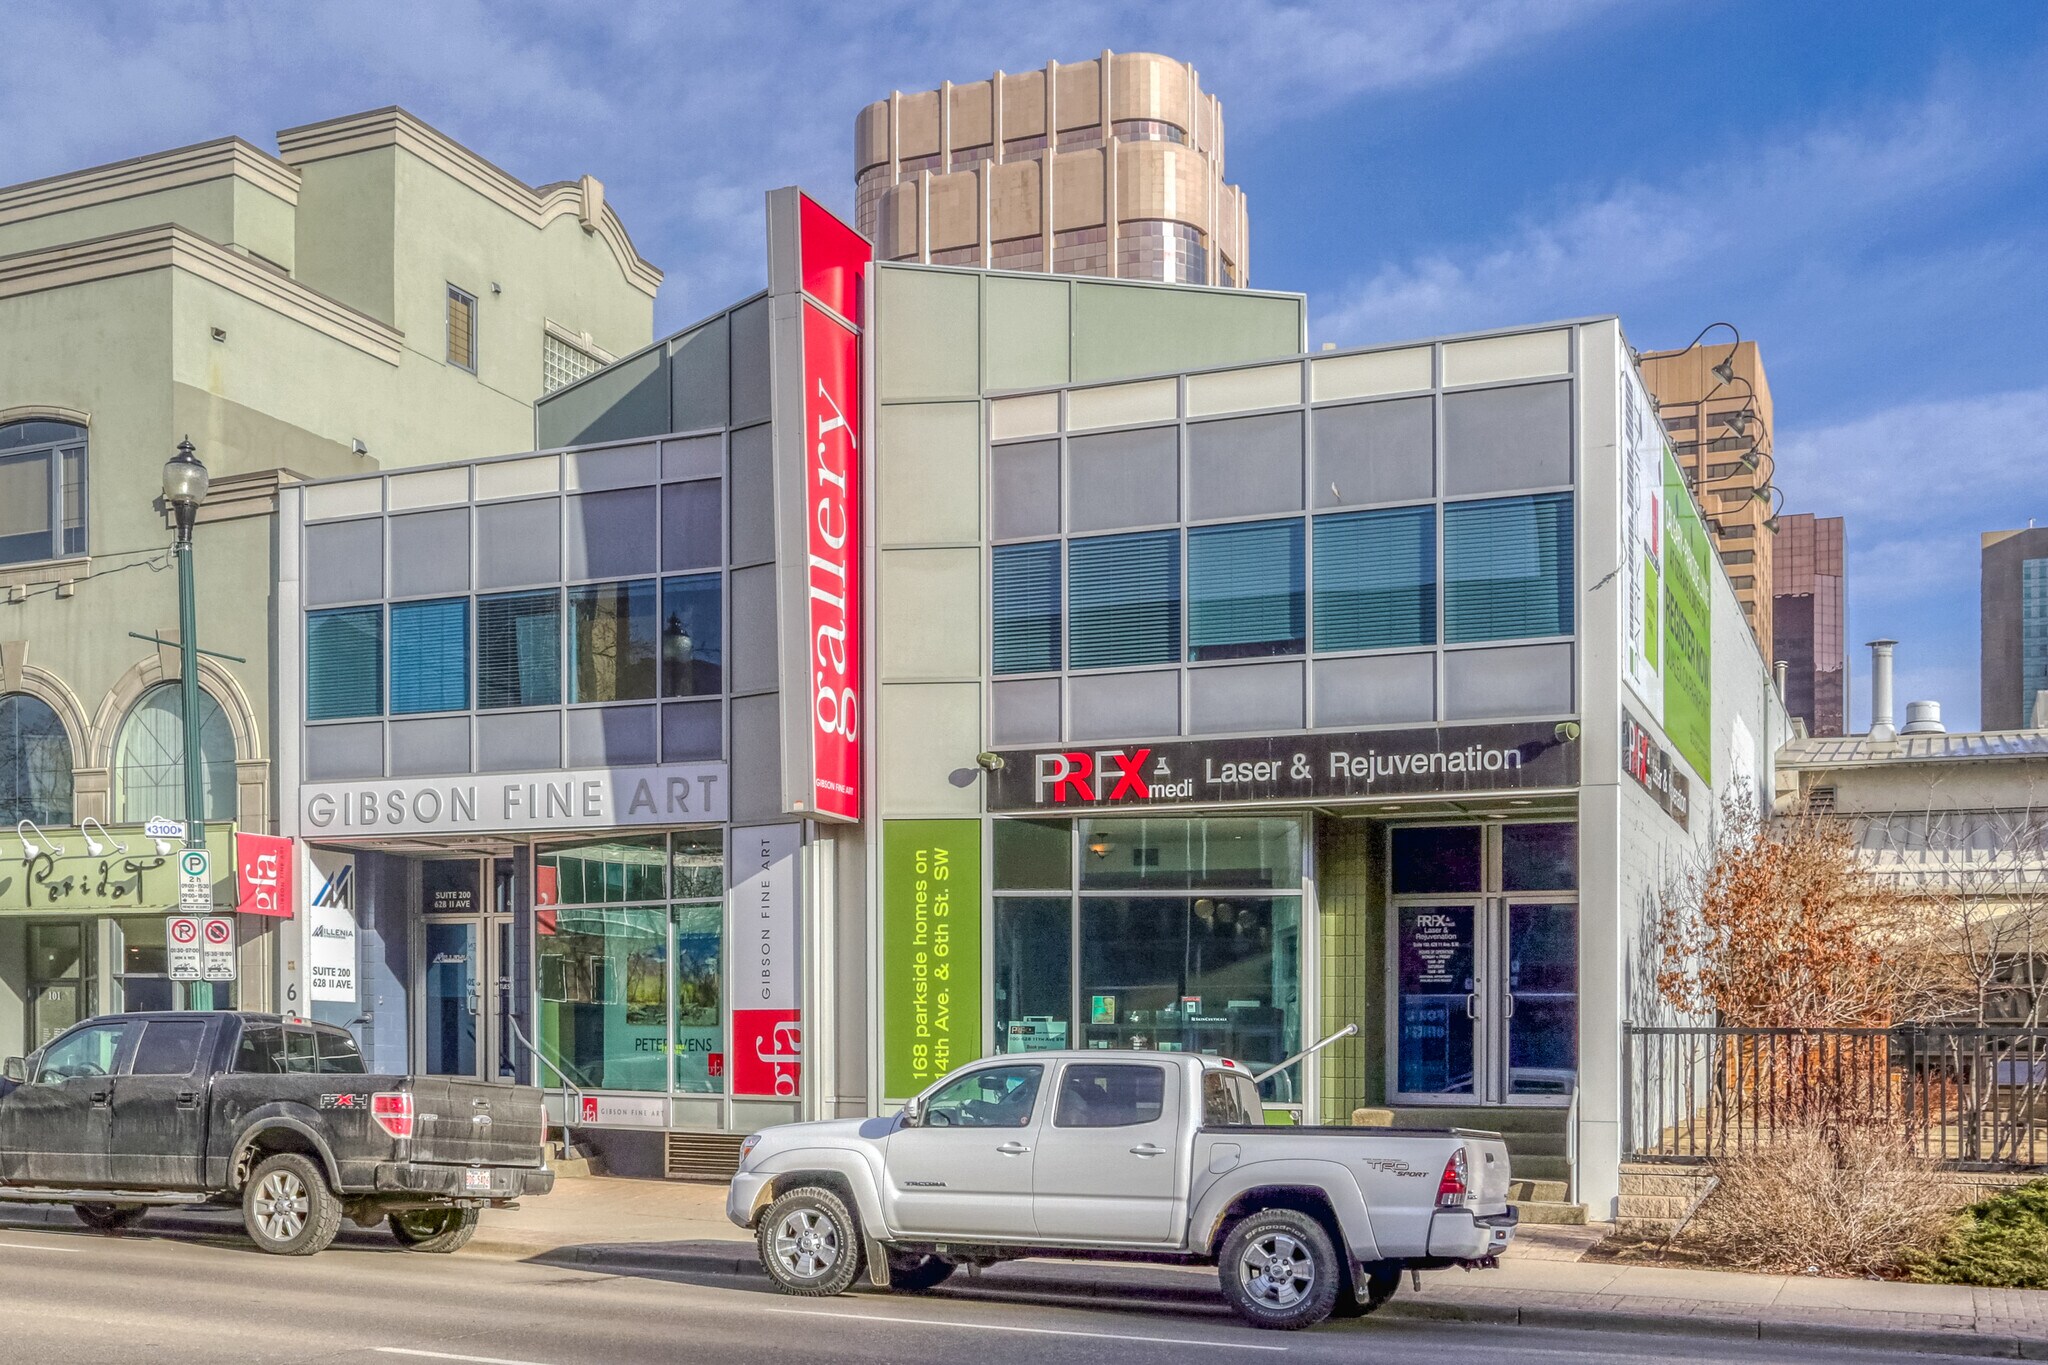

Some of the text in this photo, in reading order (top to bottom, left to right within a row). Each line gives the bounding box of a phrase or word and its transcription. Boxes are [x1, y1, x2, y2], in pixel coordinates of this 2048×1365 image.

[809, 378, 858, 743] gallery
[1666, 584, 1708, 692] REGISTER NOW
[1205, 744, 1522, 784] Laser & Rejuvenation
[816, 778, 835, 790] GIBSON
[1035, 749, 1150, 802] PRFX
[1149, 779, 1192, 797] medi
[308, 774, 718, 827] GIBSON FINE ART
[152, 825, 178, 834] 3100
[189, 857, 202, 871] P
[245, 850, 278, 910] gfa
[435, 891, 471, 900] SUITE 200
[455, 900, 471, 908] AVE
[761, 839, 771, 1000] GIBSON FINE ART
[312, 966, 351, 977] SUITE 200
[912, 849, 931, 1080] 168 parkside homes on
[934, 847, 949, 1080] 14th Ave. & 6th St. SW
[312, 979, 326, 988] 628
[336, 980, 353, 989] AVE.
[320, 1093, 368, 1105] FX4
[1367, 1161, 1409, 1172] TRD
[1245, 1224, 1307, 1240] BFGoodrich
